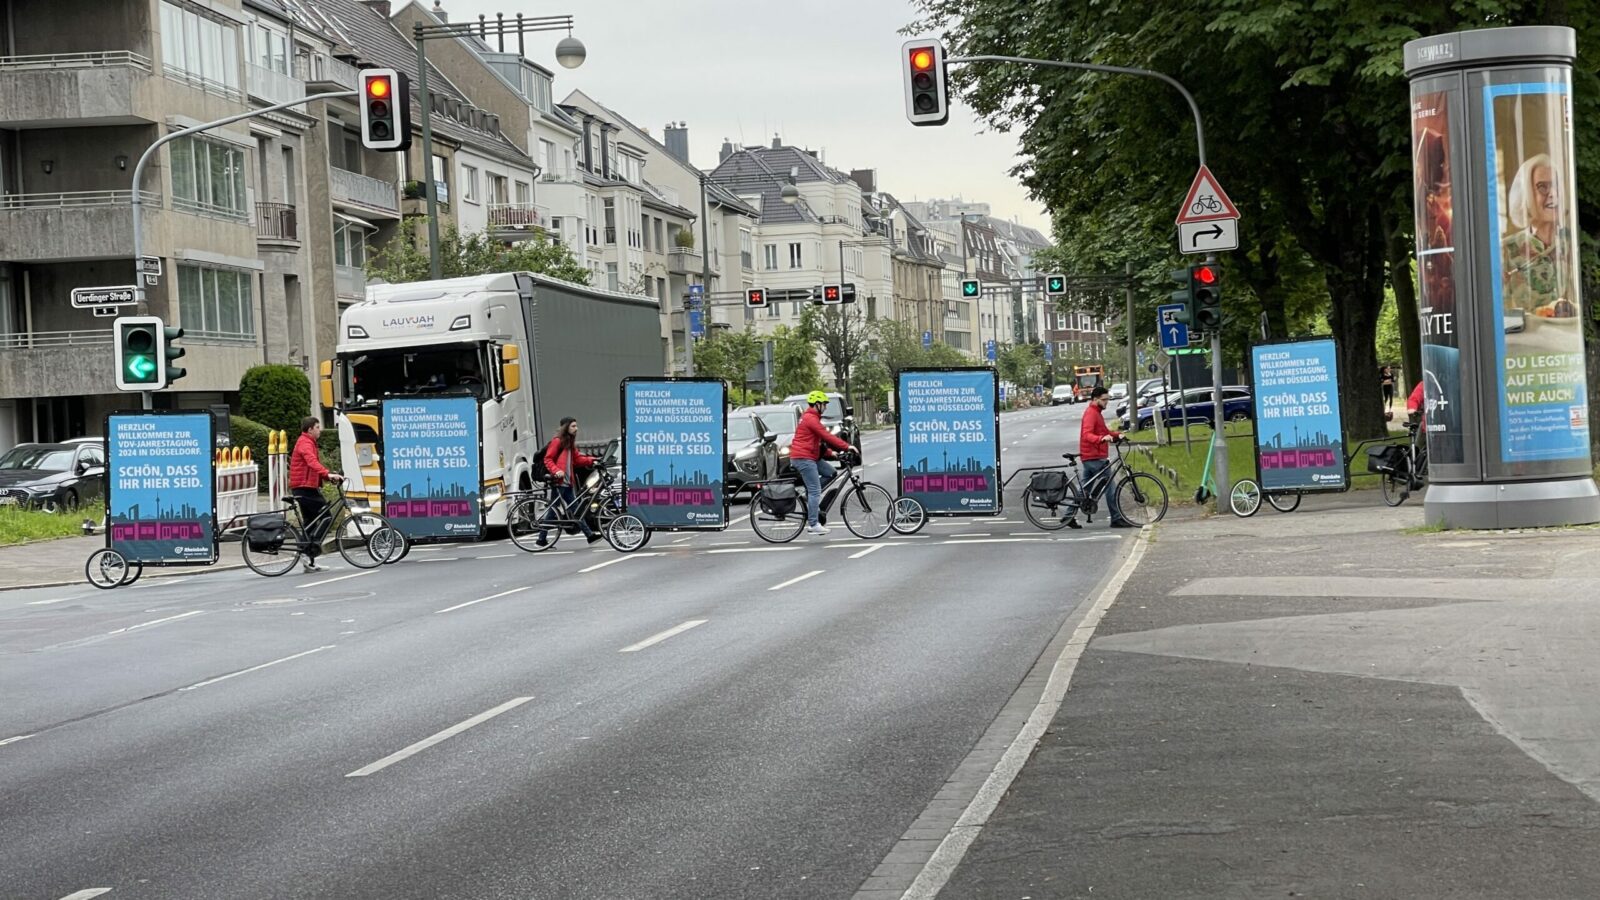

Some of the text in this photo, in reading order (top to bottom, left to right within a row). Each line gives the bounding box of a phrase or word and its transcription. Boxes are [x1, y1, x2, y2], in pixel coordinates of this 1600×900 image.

[77, 291, 131, 303] Uerdinger Straße
[1260, 352, 1290, 360] HERZLICH
[1506, 357, 1527, 370] DU
[1531, 353, 1566, 368] LEGST
[1260, 358, 1320, 369] WILLKOMMEN ZUR
[1260, 366, 1327, 378] VDV-JAHRESTAGUNG
[908, 380, 943, 388] HERZLICH
[1262, 374, 1330, 386] 2024 IN DÜSSELDORF.
[1506, 373, 1534, 387] AUF
[635, 390, 671, 398] HERZLICH
[908, 388, 959, 396] WILLKOMMEN
[1507, 388, 1575, 404] WIR AUCH.
[908, 396, 983, 404] VDV-JAHRESTAGUNG
[1262, 392, 1327, 406] SCHÖN, DASS
[391, 406, 426, 415] HERZLICH
[938, 402, 986, 411] DÜSSELDORF.
[1264, 404, 1333, 418] IHR HIER SEID.
[665, 414, 715, 423] DÜSSELDORF.
[117, 423, 155, 431] HERZLICH
[392, 422, 466, 430] VDV-JAHRESTAGUNG
[909, 419, 982, 432] SCHÖN, DASS
[118, 431, 191, 440] WILLKOMMEN ZUR
[421, 429, 469, 438] DÜSSELDORF.
[635, 430, 710, 444] SCHÖN, DASS
[910, 432, 987, 443] IHR HIER SEID.
[118, 440, 199, 448] VDV-JAHRESTAGUNG
[636, 444, 715, 455] IHR HIER SEID.
[118, 447, 202, 457] 2024 IN DÜSSELDORF.
[392, 445, 466, 458] SCHÖN, DASS
[393, 458, 471, 469] IHR HIER SEID.
[119, 464, 198, 477] SCHÖN, DASS
[120, 477, 203, 490] IHR HIER SEID.
